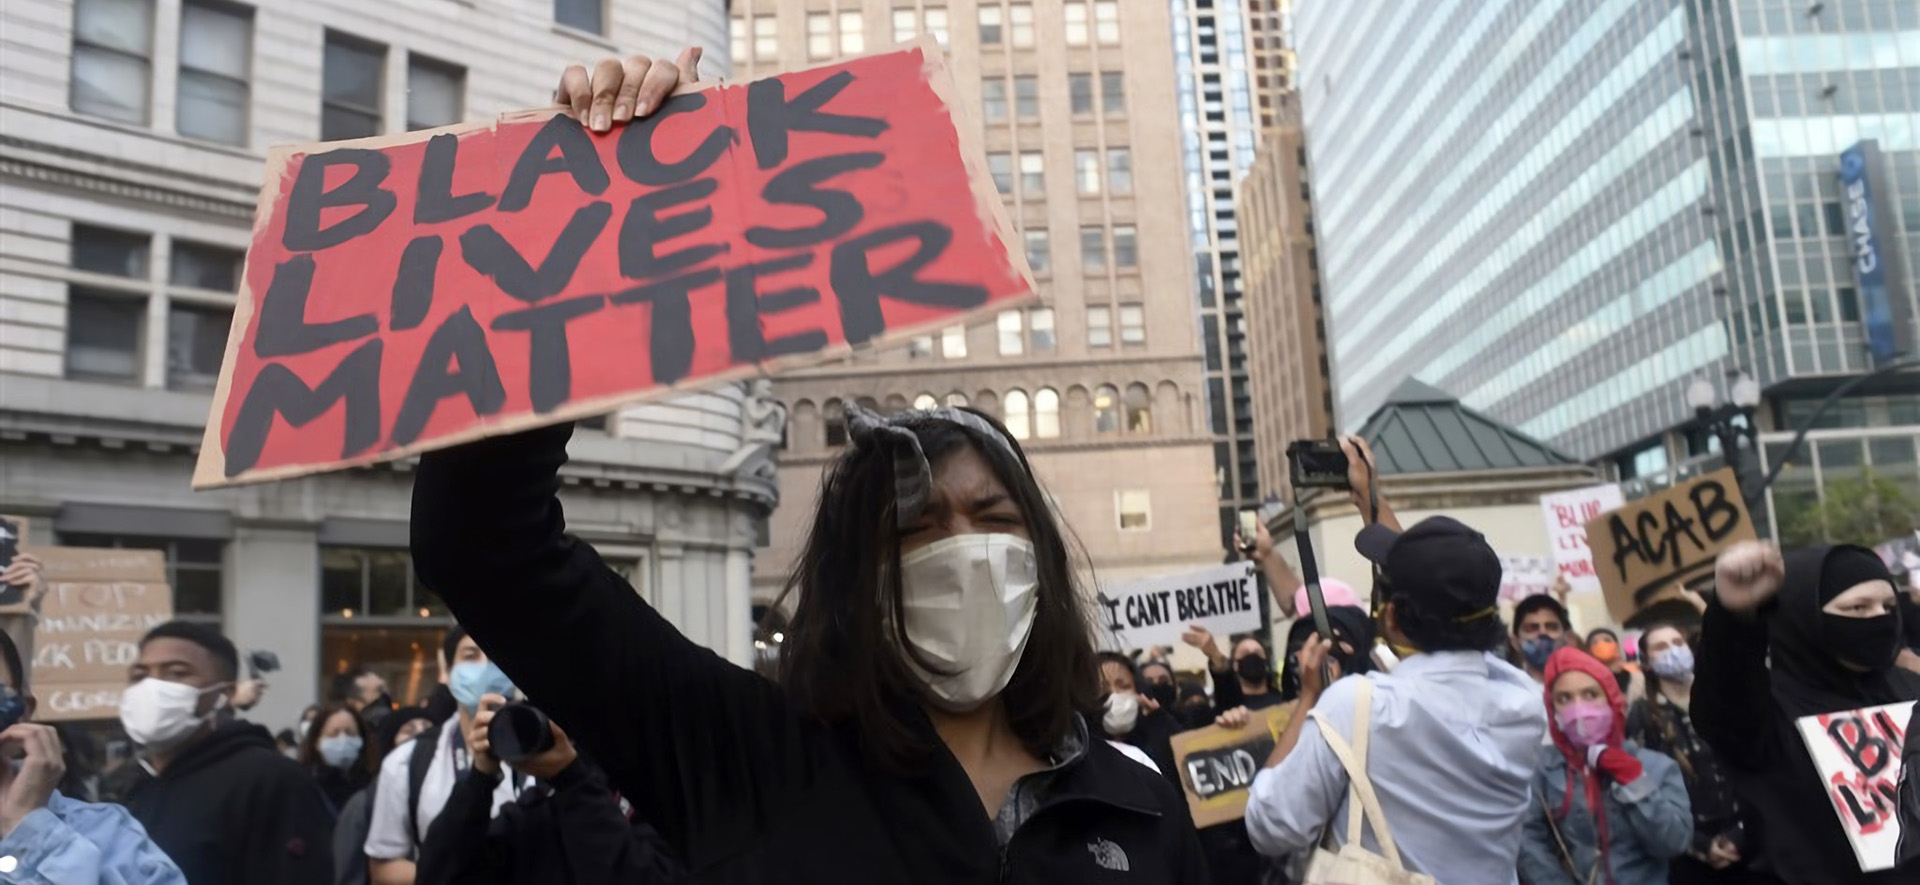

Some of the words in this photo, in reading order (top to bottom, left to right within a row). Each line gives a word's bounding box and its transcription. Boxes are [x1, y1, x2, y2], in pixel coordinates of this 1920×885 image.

[282, 71, 888, 251] BLACK
[253, 152, 886, 357] LIVES
[1847, 178, 1876, 274] CHASE
[224, 221, 988, 477] MATTER
[1609, 481, 1739, 584] ACAB
[1126, 590, 1170, 628] CANT
[1187, 749, 1256, 796] END
